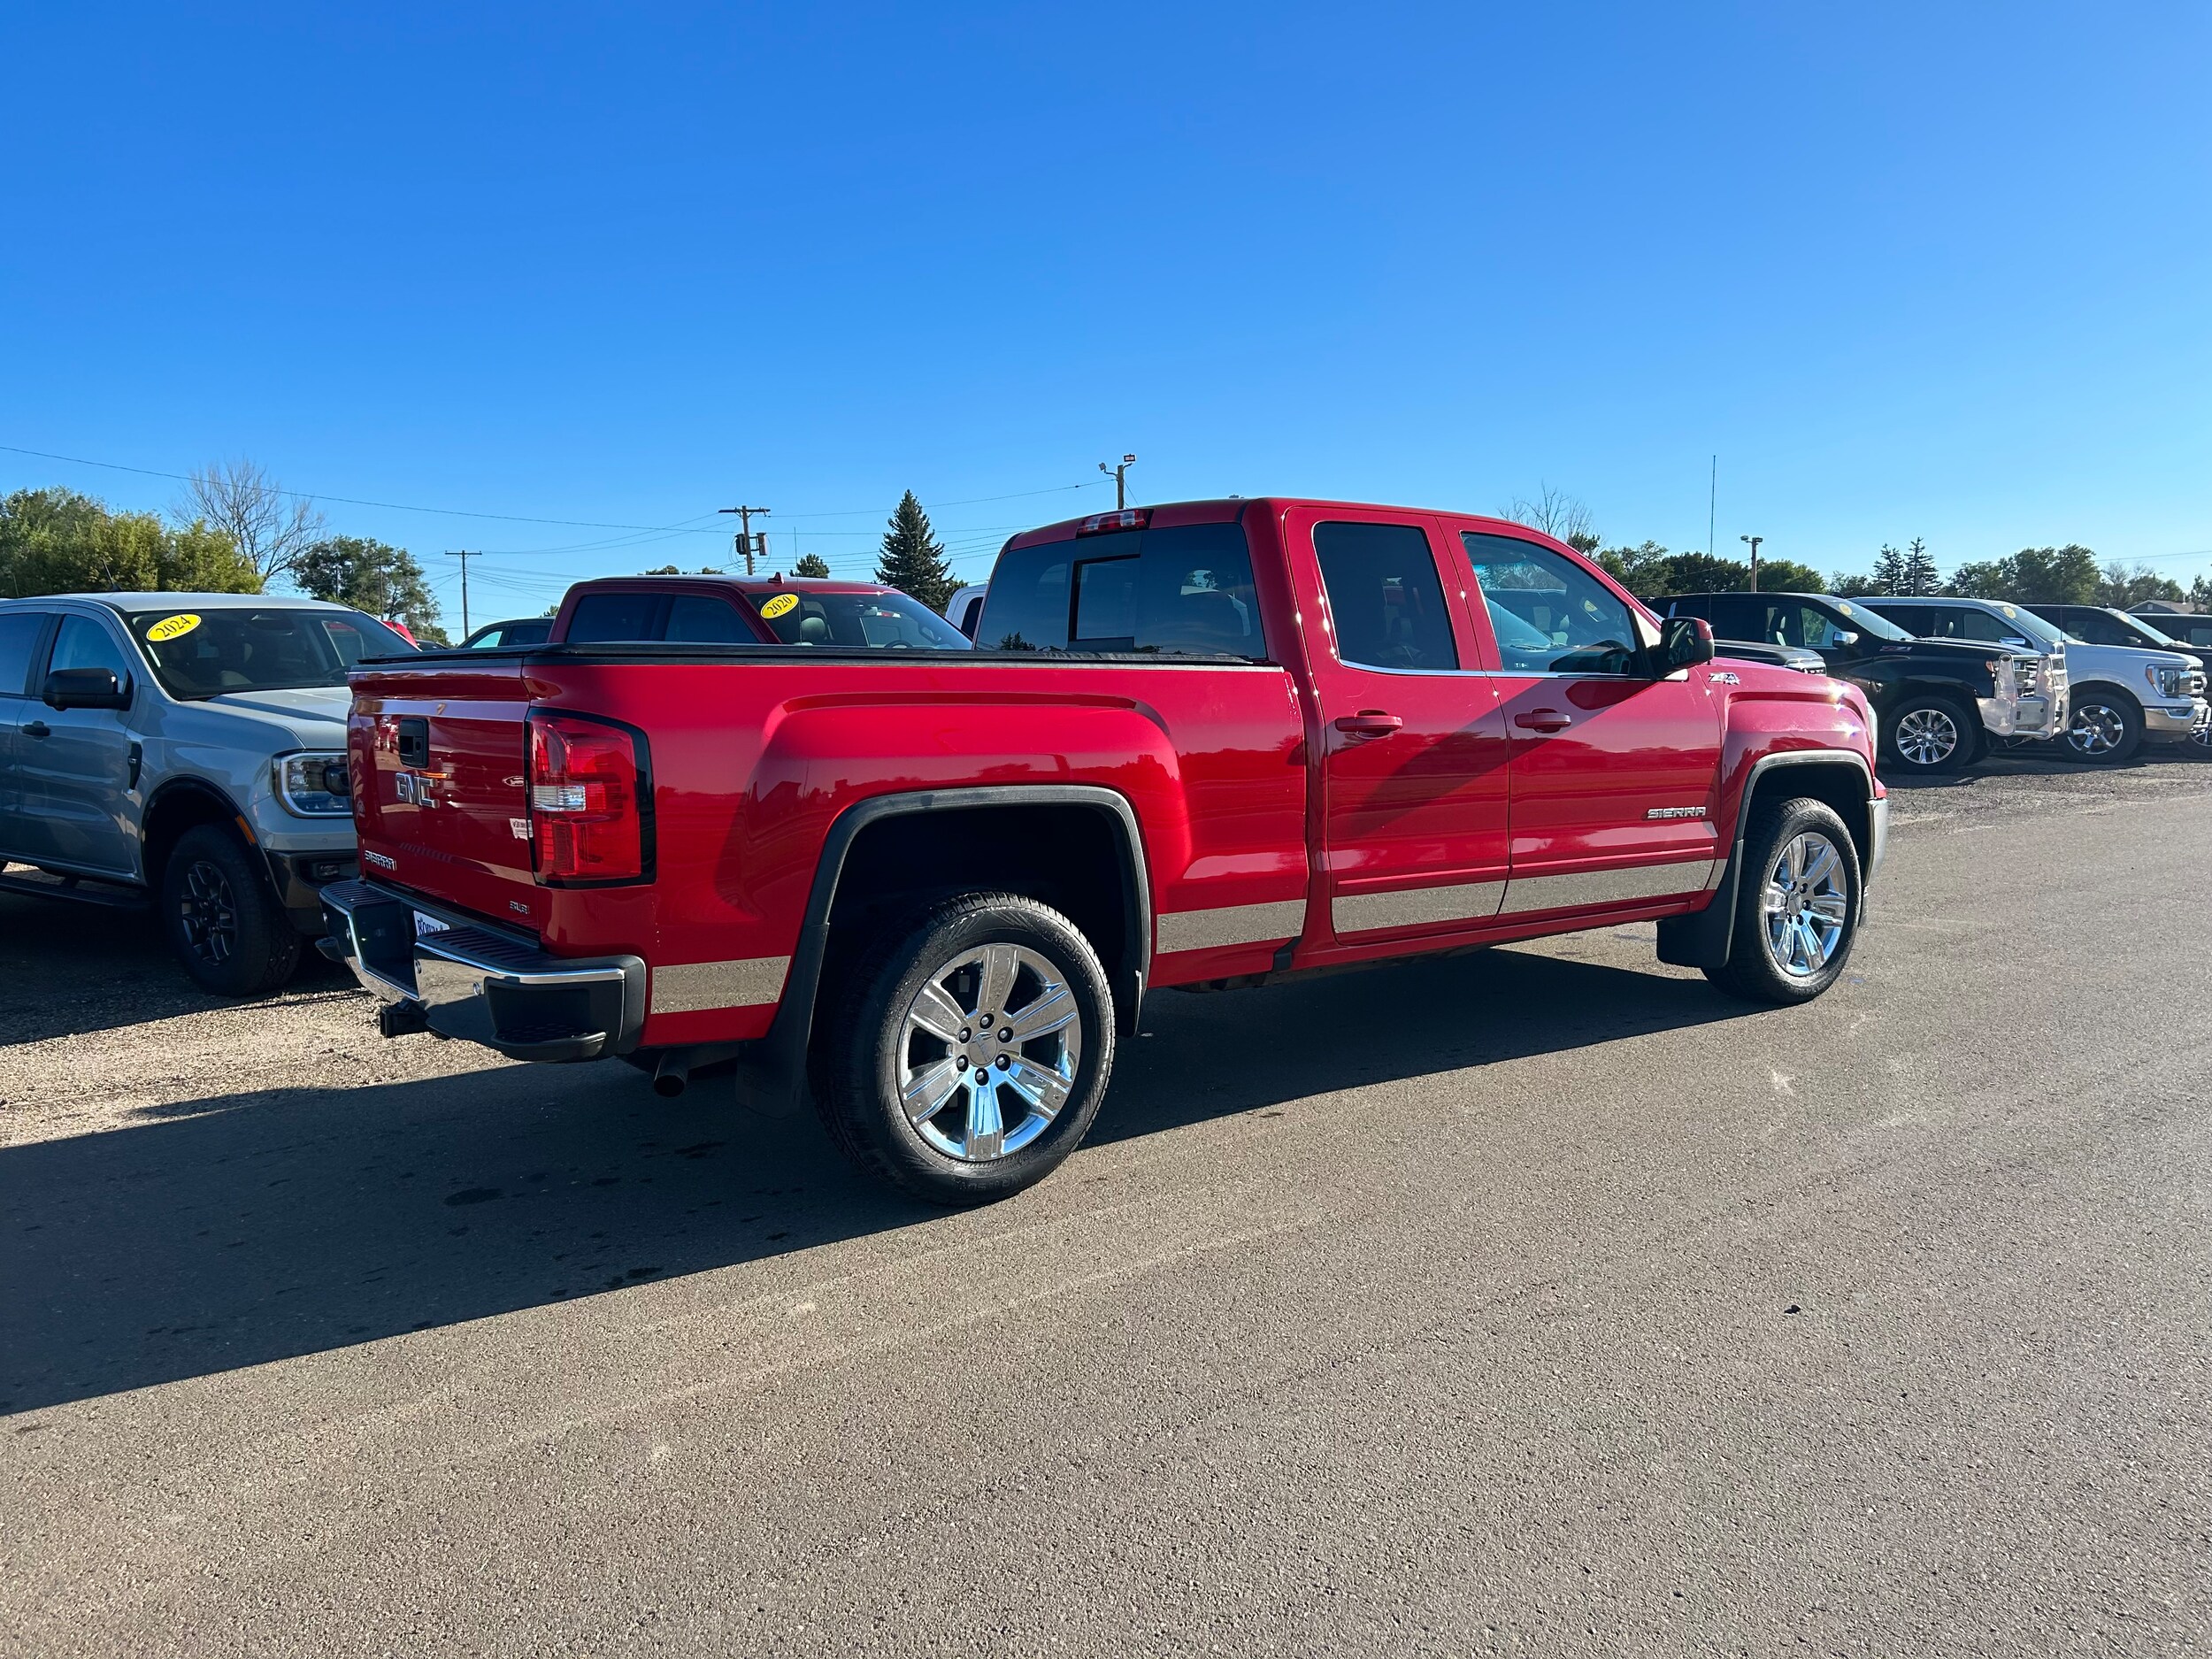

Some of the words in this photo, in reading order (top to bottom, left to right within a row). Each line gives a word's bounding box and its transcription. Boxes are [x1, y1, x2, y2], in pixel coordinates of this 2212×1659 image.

[766, 595, 793, 616] 2020
[155, 615, 191, 638] 2024
[396, 772, 440, 809] GMC
[1647, 806, 1707, 819] SIERRA
[365, 849, 397, 872] SIERRA
